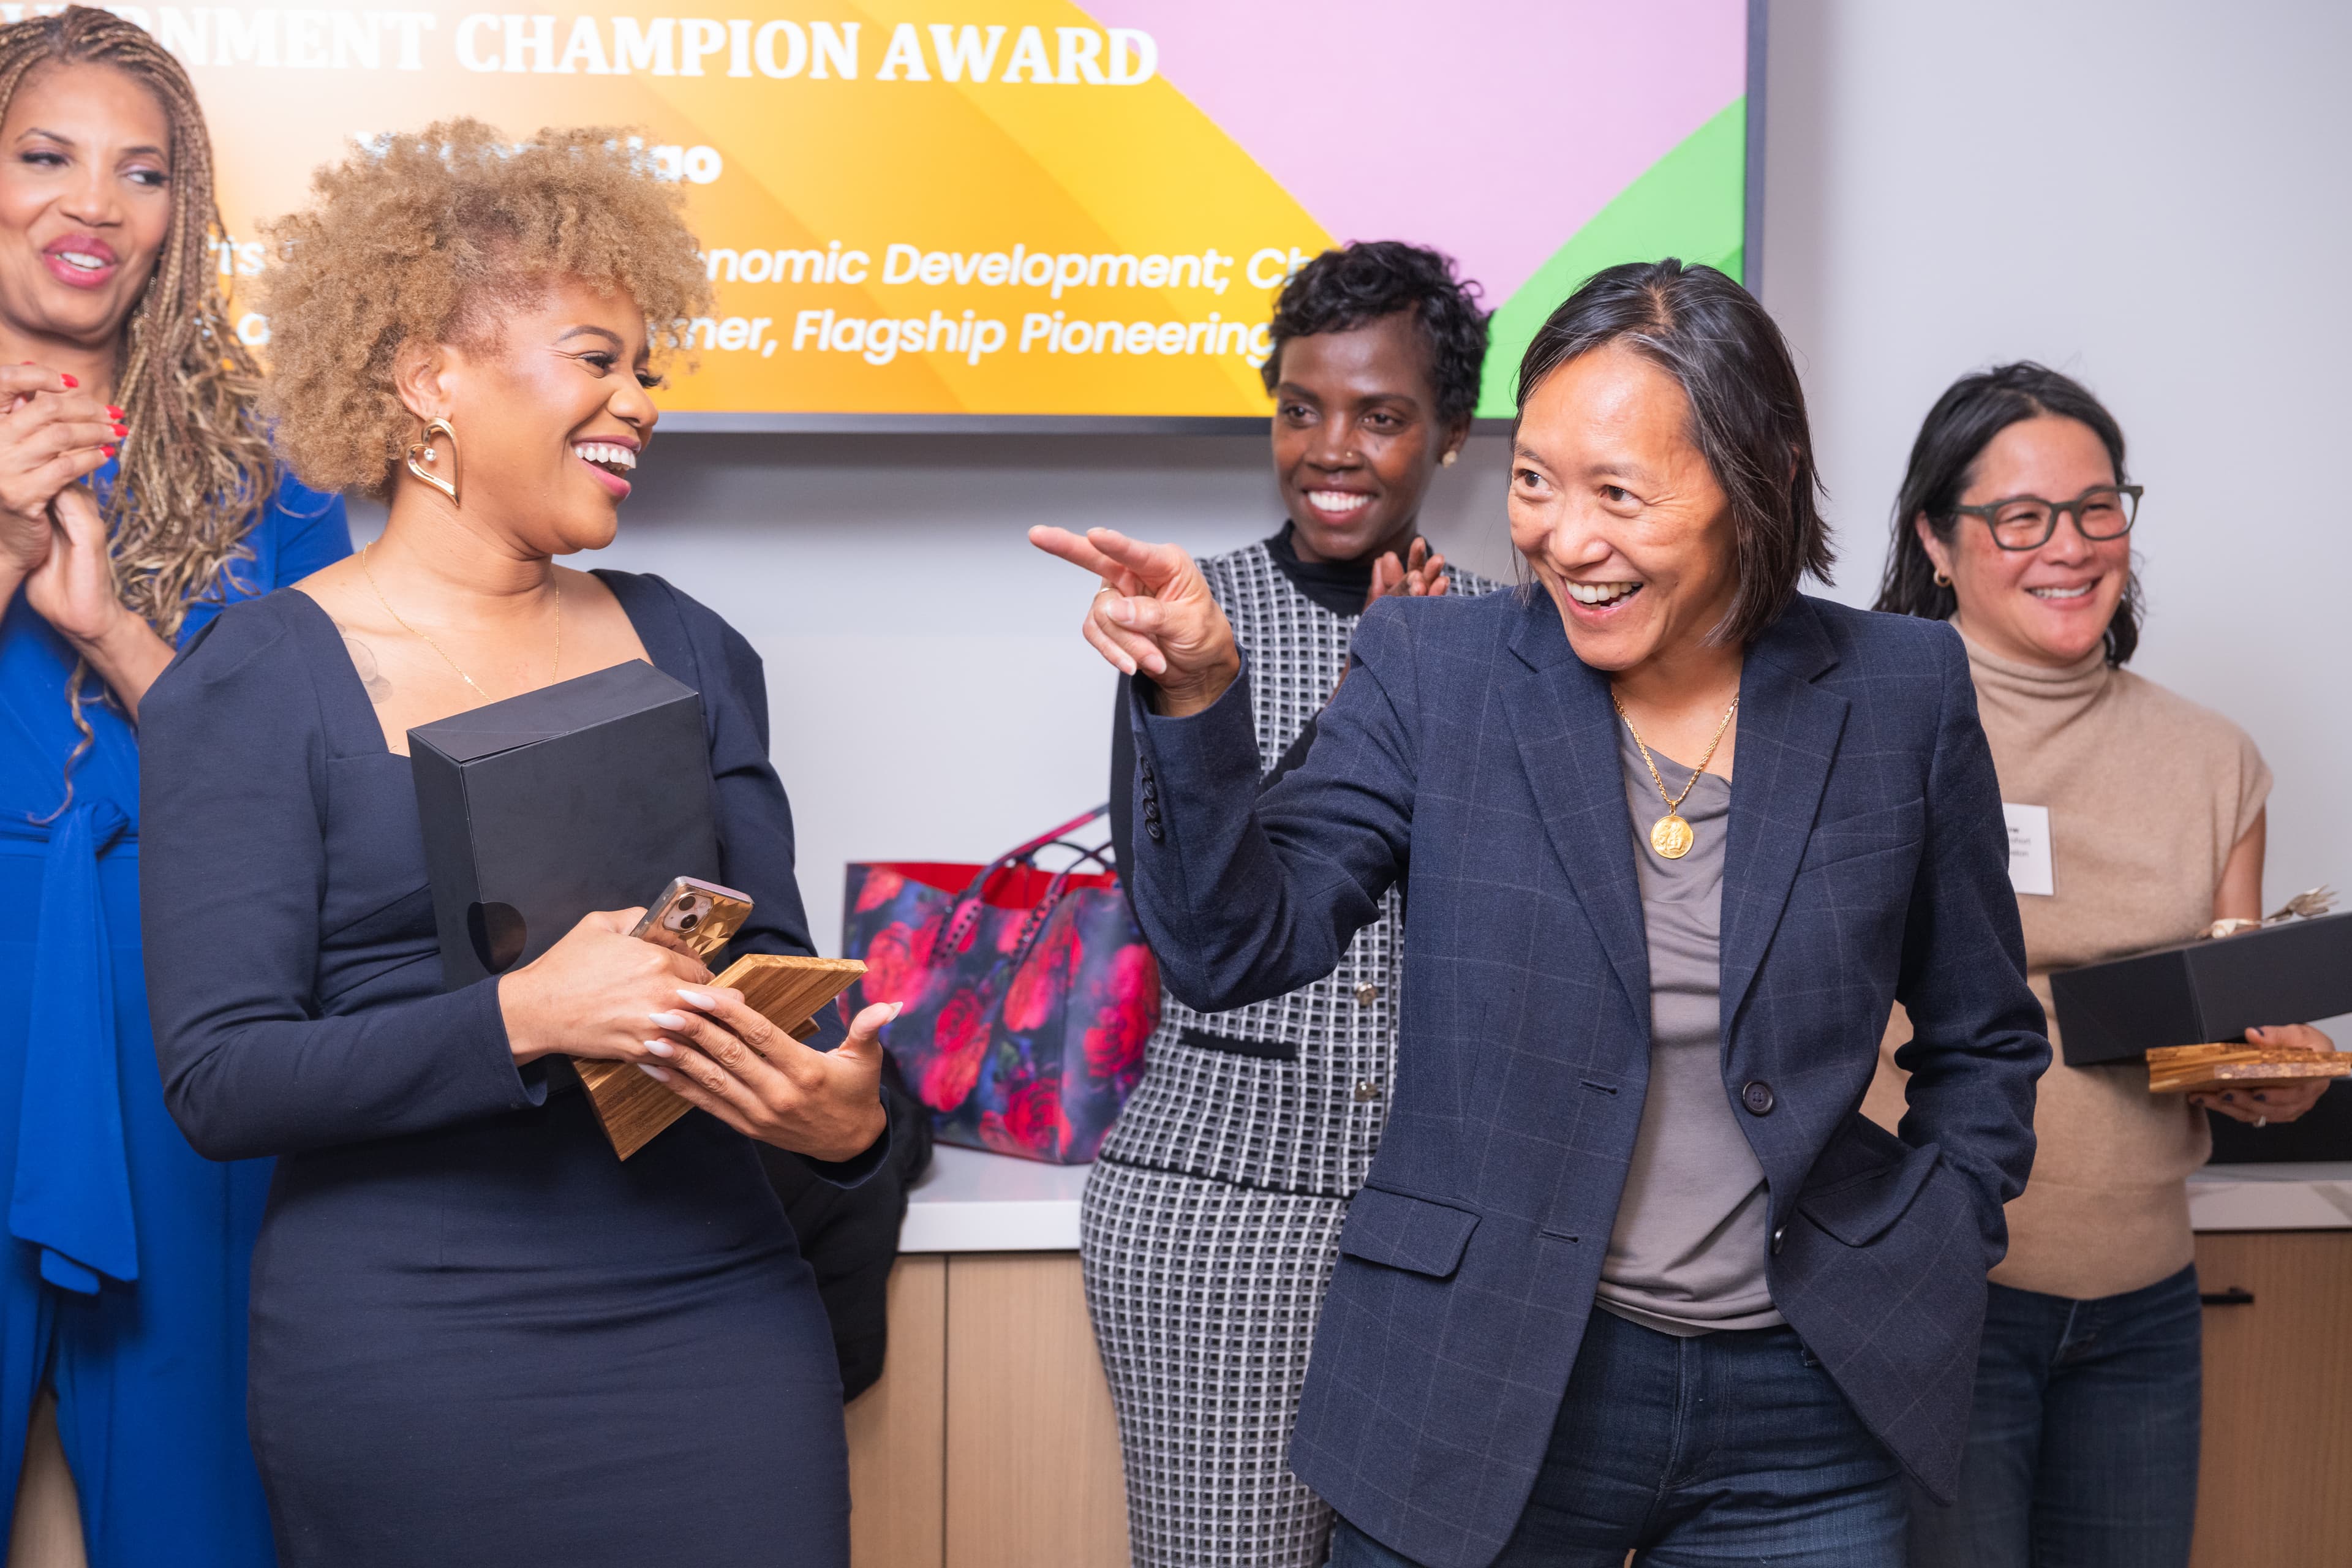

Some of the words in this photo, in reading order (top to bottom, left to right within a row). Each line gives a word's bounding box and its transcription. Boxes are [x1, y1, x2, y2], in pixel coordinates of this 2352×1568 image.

[0, 3, 437, 72] NMENT
[454, 13, 861, 80] CHAMPION
[876, 22, 1158, 86] AWARD
[695, 239, 870, 284] nomic
[882, 243, 1235, 299] Development;
[1246, 247, 1313, 289] Ch
[792, 308, 1006, 365] Flagship
[1019, 311, 1276, 369] Pioneering
